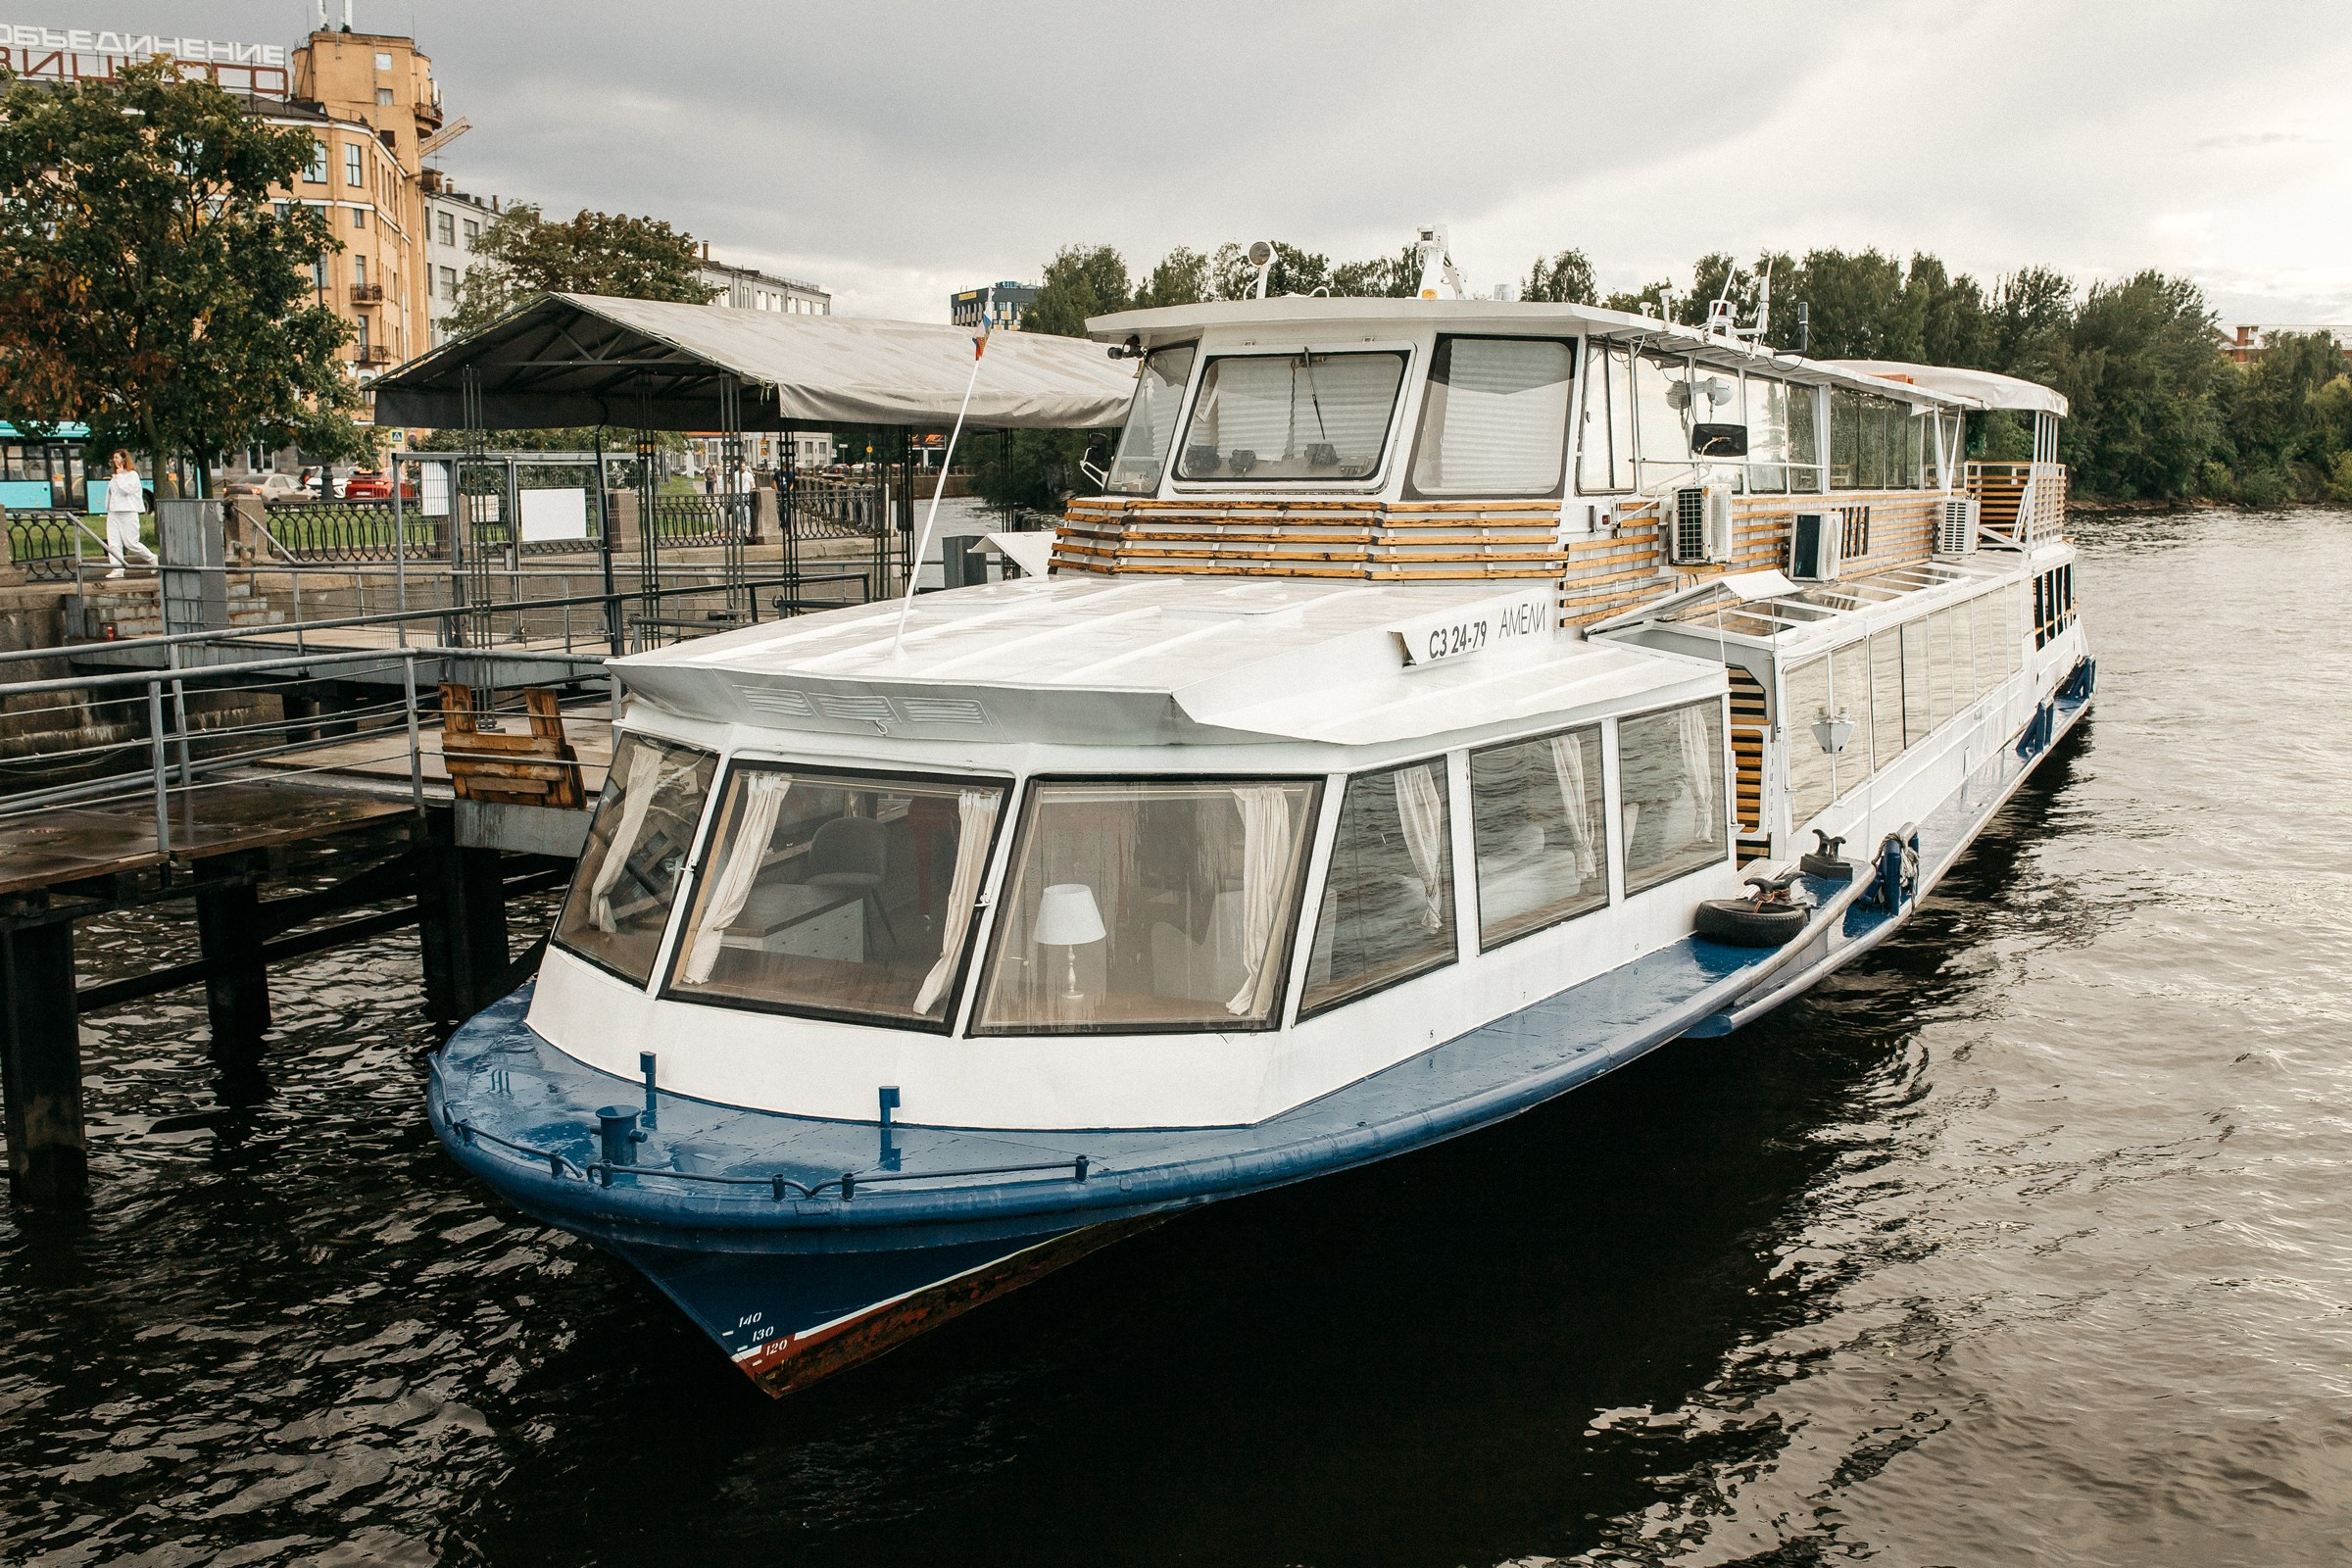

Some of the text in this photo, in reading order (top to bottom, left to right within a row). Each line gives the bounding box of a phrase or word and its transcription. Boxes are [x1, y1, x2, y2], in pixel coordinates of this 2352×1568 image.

[1451, 620, 1488, 655] 24-79
[1498, 602, 1545, 639] АМЕЛИ
[739, 1311, 762, 1328] 140
[753, 1326, 774, 1343] 130
[766, 1340, 788, 1356] 120
